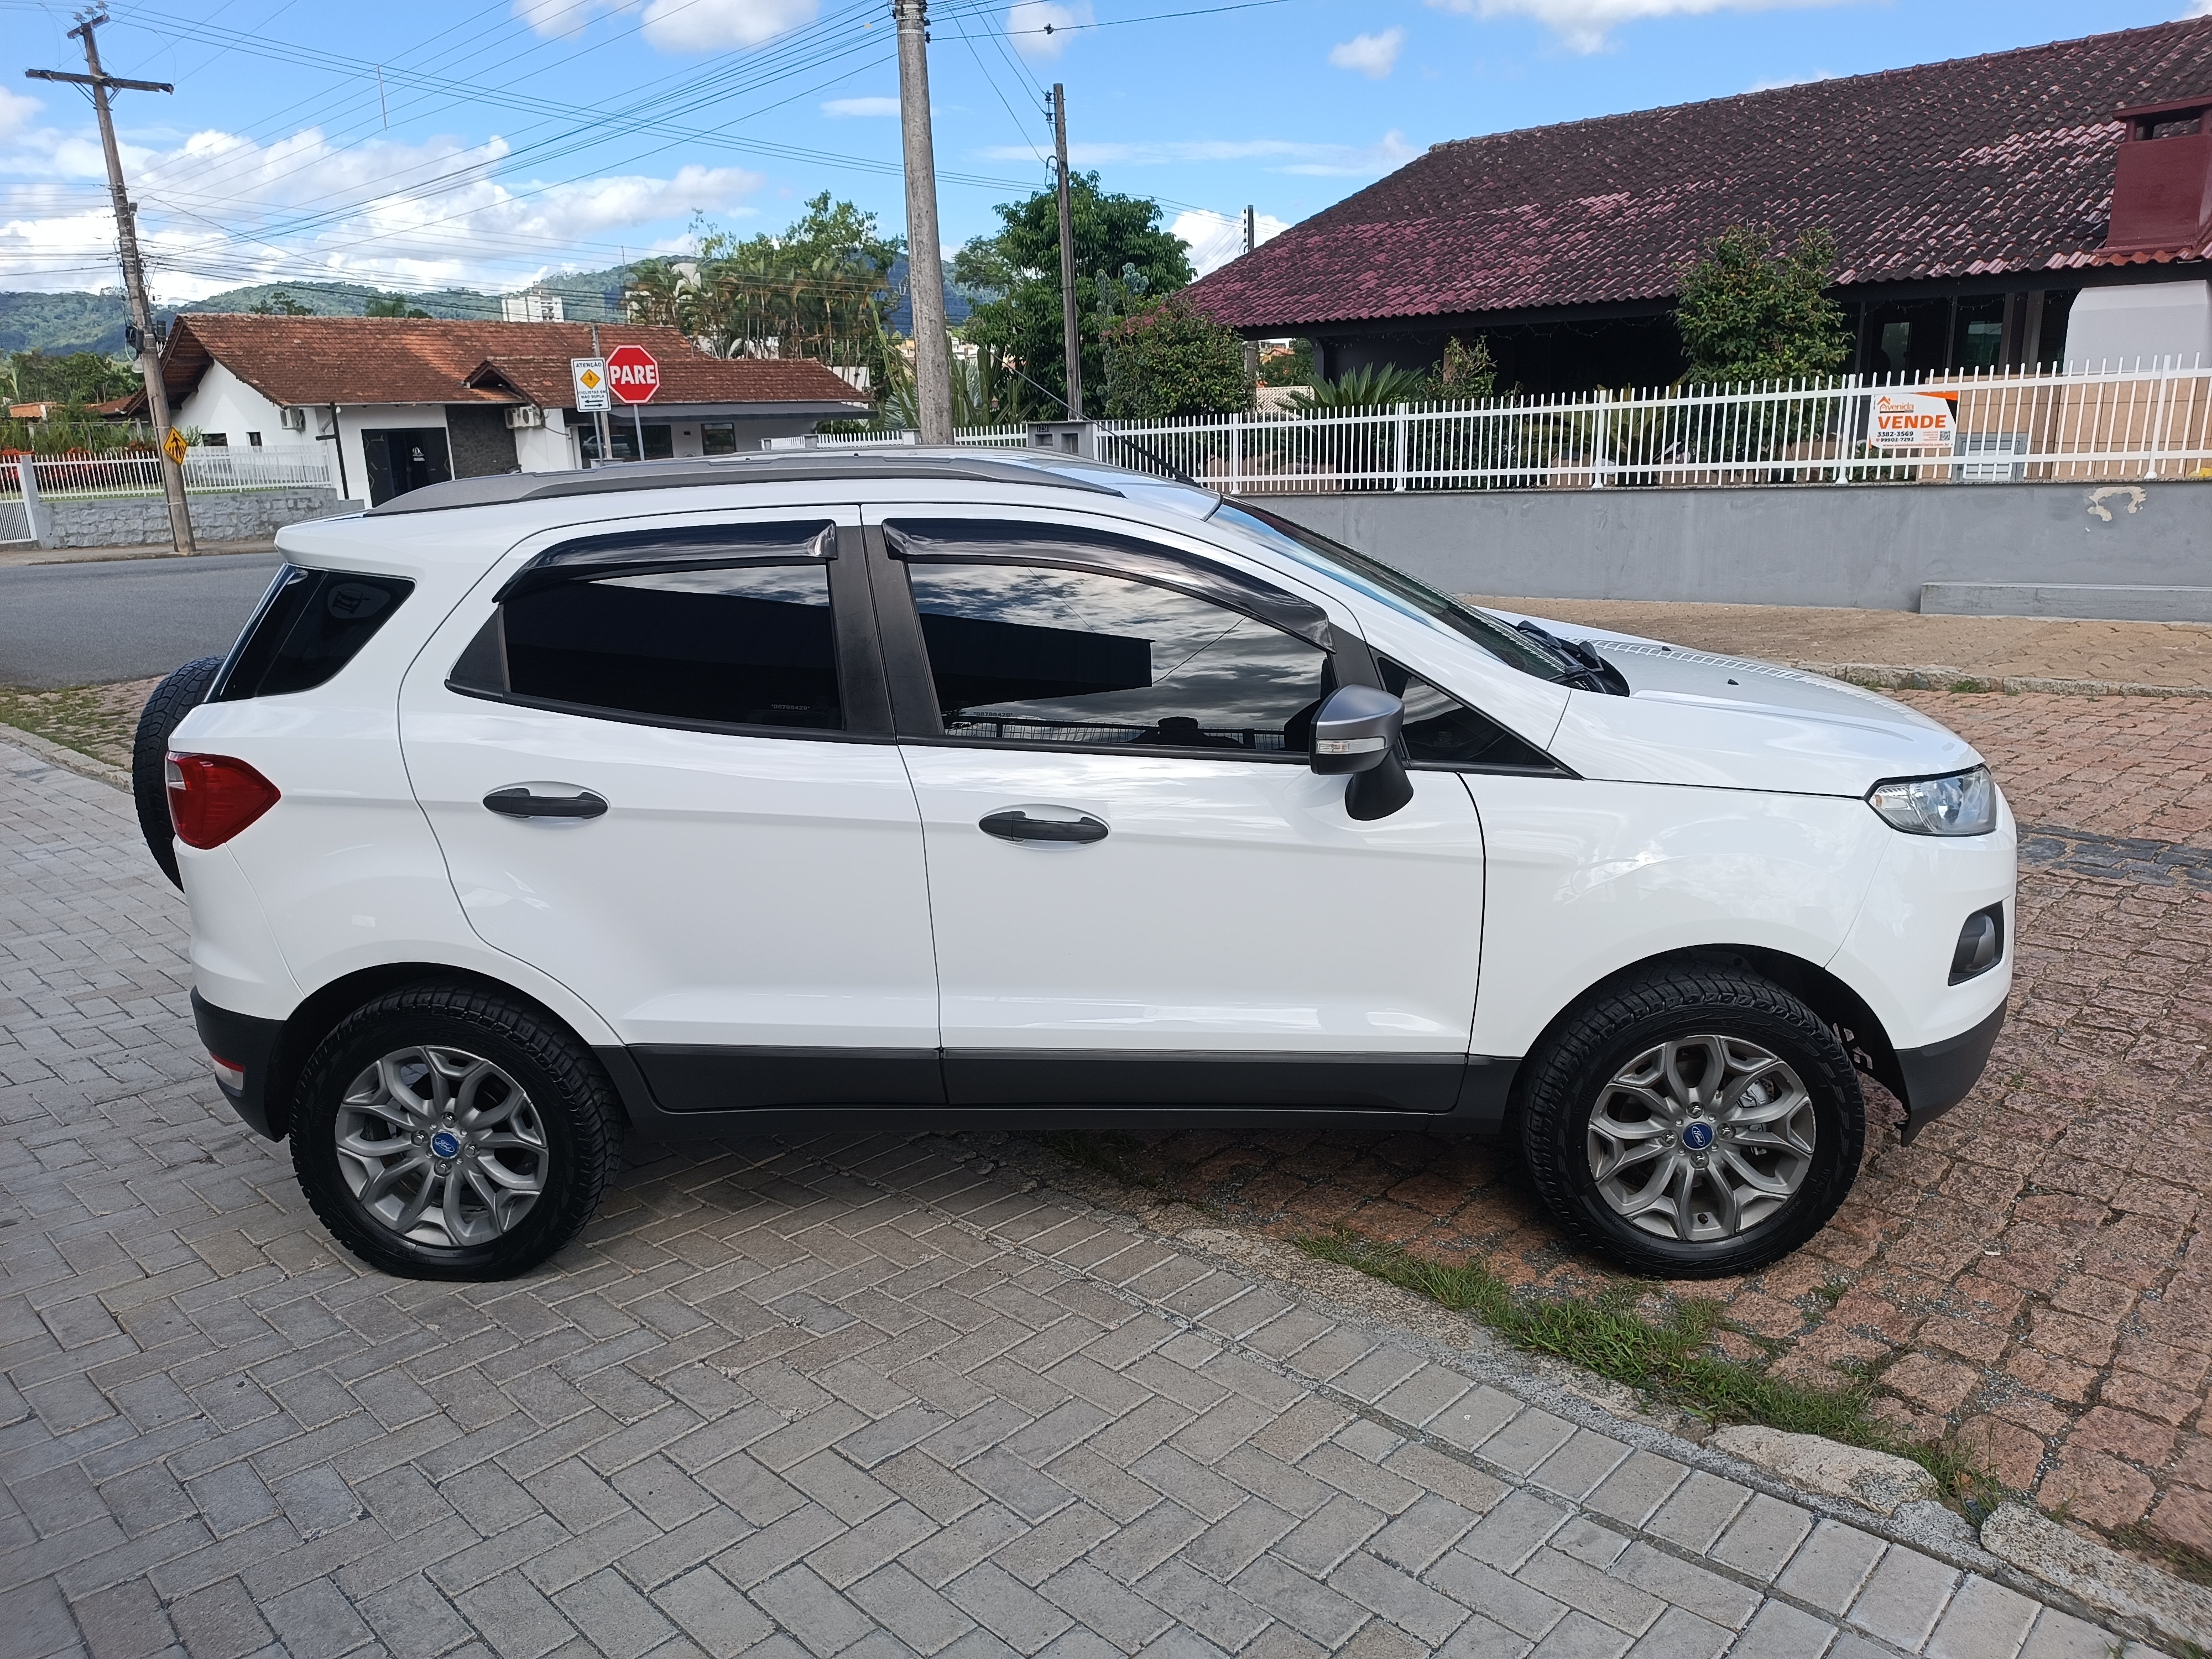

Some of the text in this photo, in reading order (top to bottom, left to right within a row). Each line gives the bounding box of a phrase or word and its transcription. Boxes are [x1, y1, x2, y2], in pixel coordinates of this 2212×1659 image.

[609, 365, 656, 384] PARE
[1880, 403, 1914, 411] Avenida
[1878, 415, 1947, 429] VENDE
[436, 1139, 453, 1151] Ford
